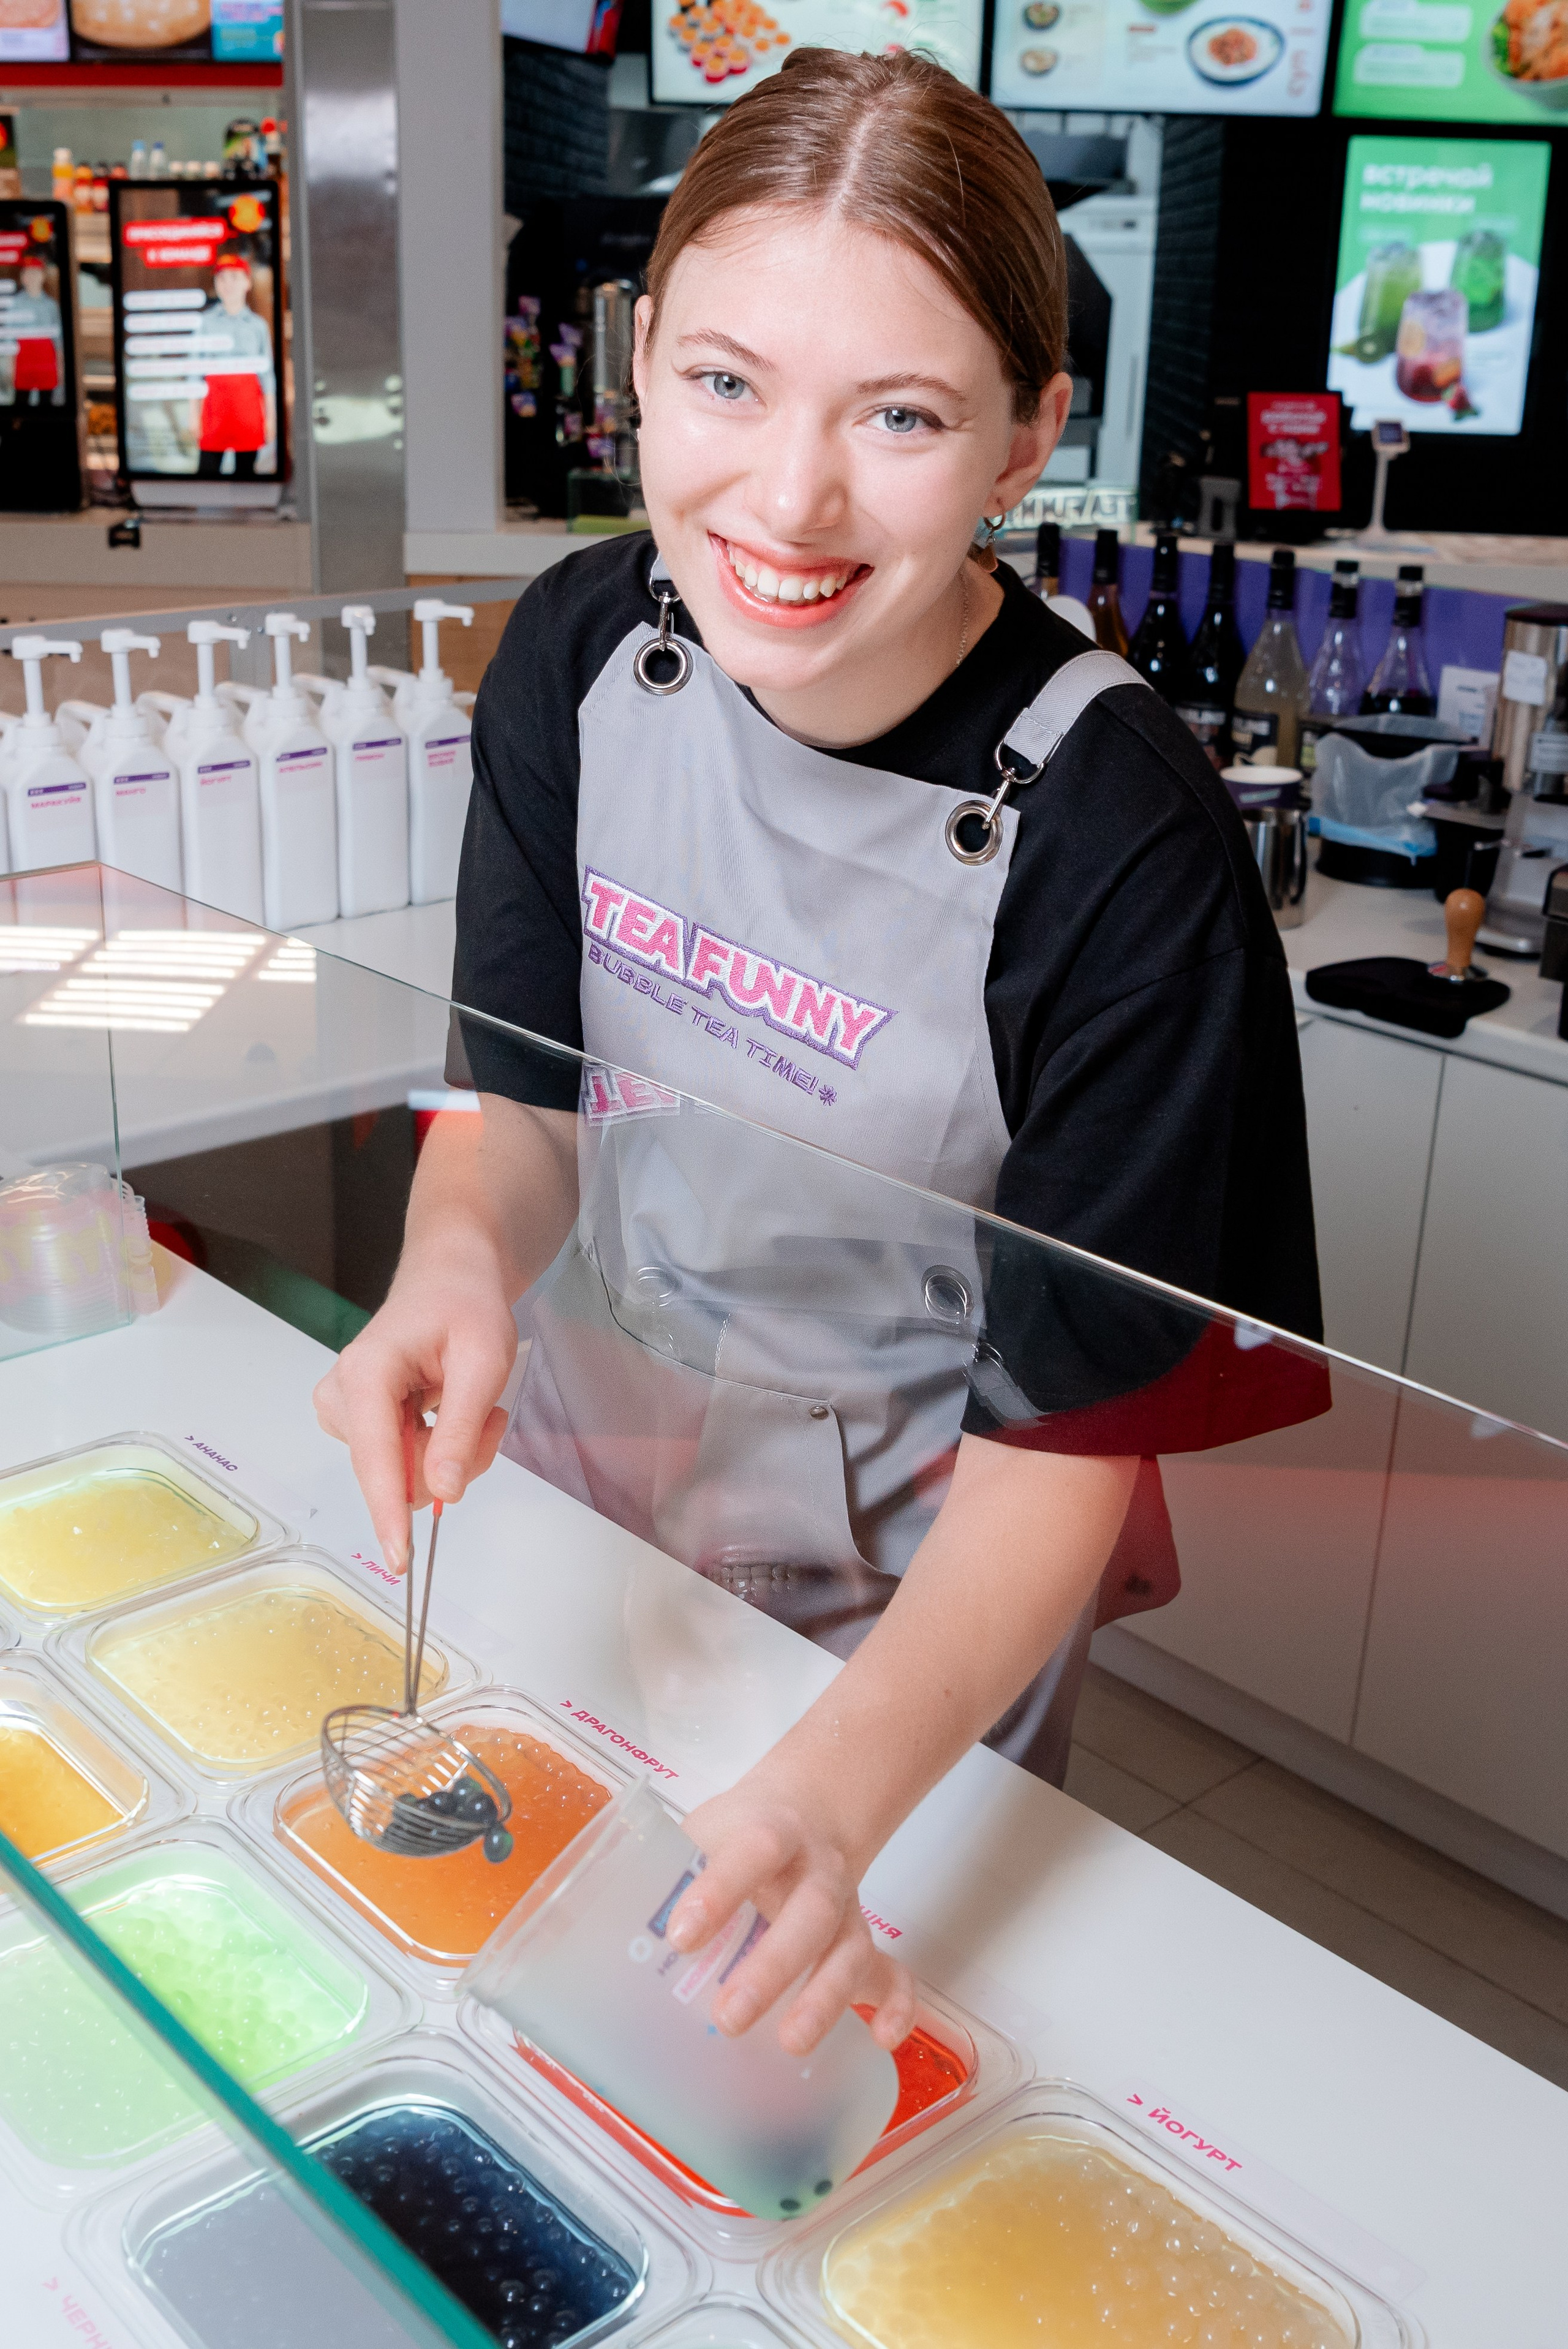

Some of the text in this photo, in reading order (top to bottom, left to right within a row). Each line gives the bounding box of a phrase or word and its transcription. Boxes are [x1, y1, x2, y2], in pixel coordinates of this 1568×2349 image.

[587, 943, 687, 1016] BUBBLE
[691, 1005, 740, 1049] TEA
[192, 1442, 238, 1471] АНАНАС
[360, 1560, 401, 1585] ЛИЧИ
[570, 1710, 679, 1779] ДРАГОНФРУТ
[860, 1905, 903, 1940] ШНЯ
[1147, 2107, 1243, 2171] ЙОГУРТ
[61, 2295, 112, 2349] ЧЕРН
